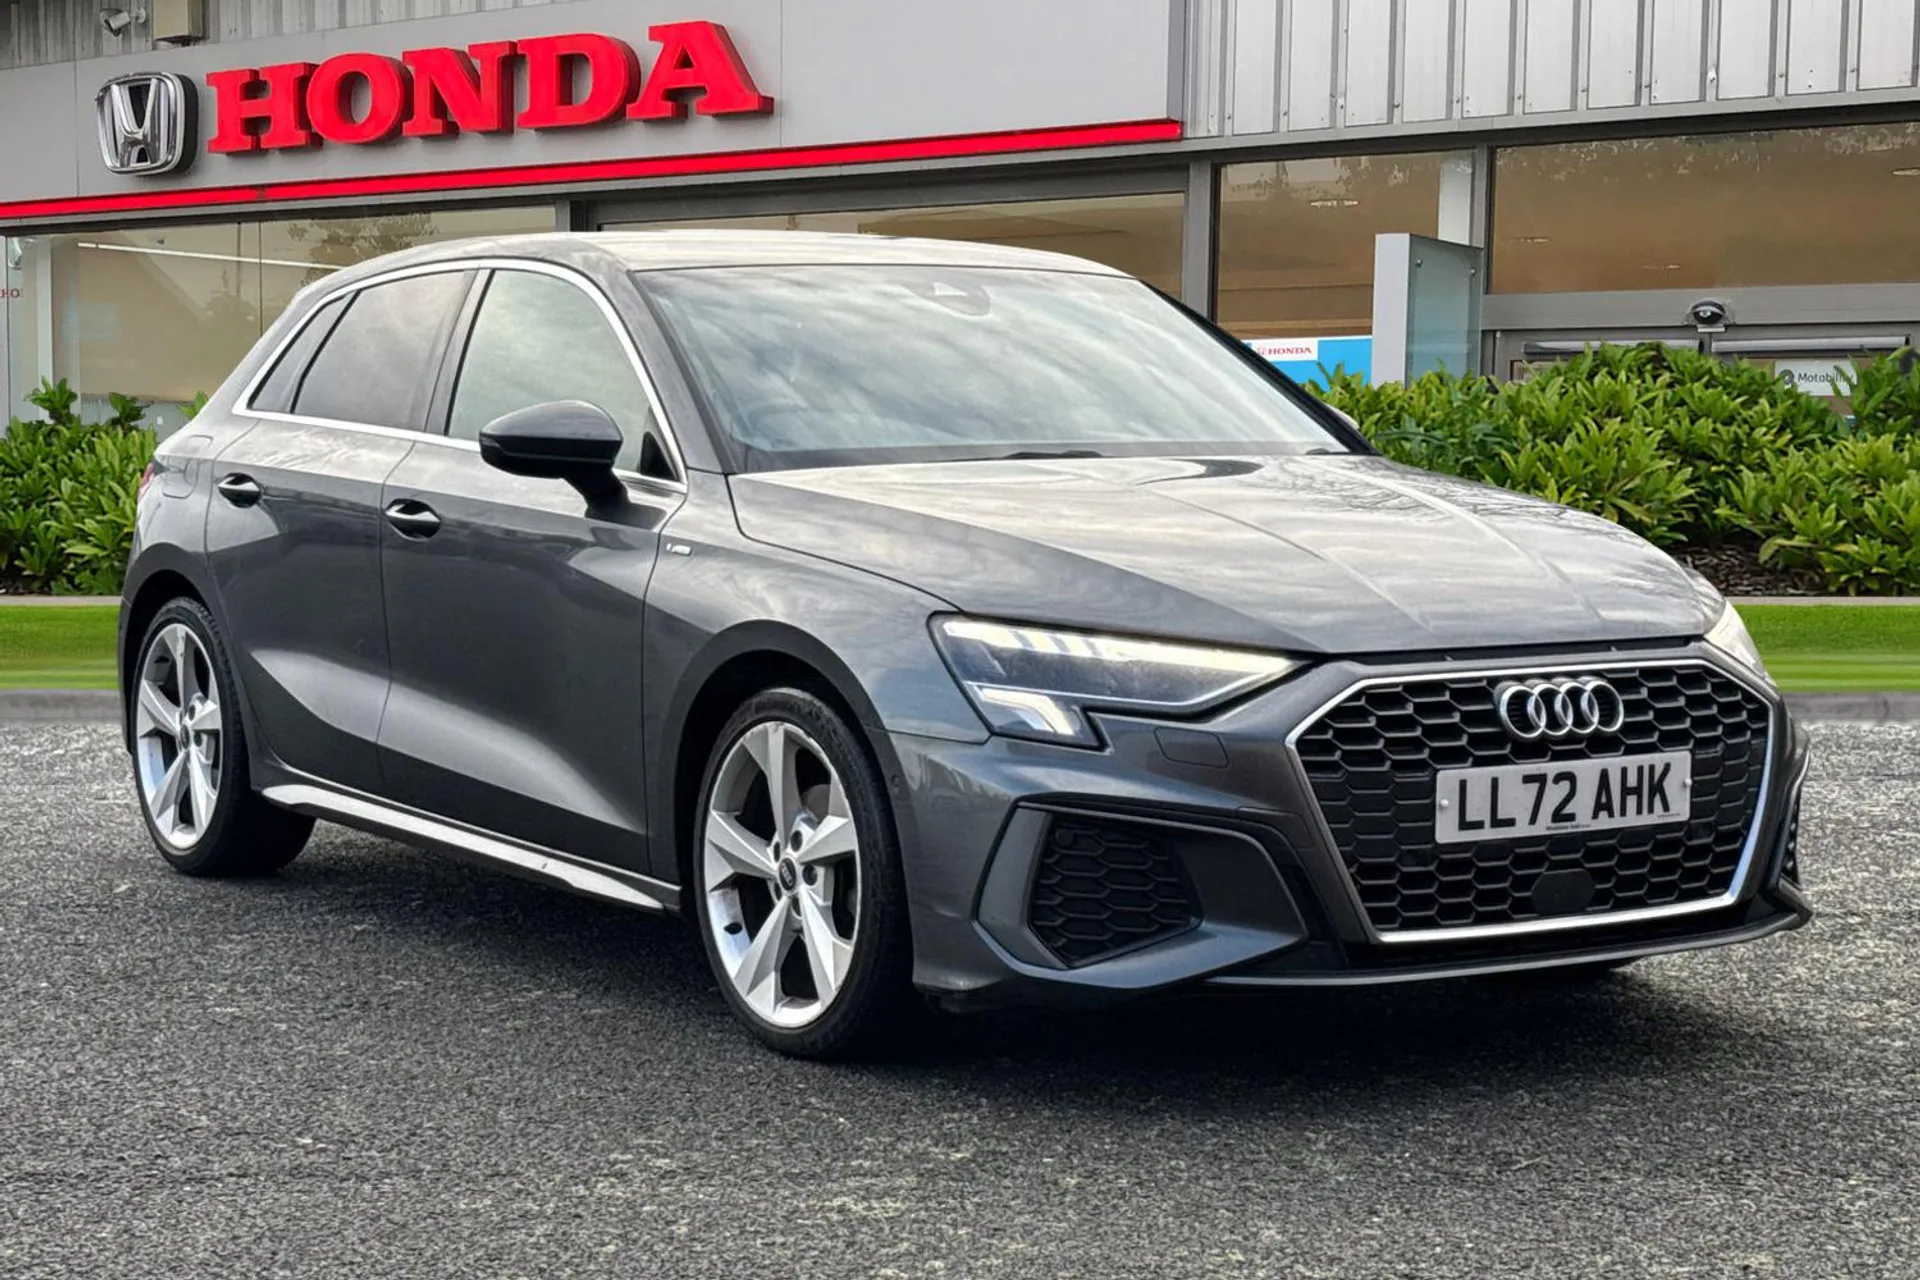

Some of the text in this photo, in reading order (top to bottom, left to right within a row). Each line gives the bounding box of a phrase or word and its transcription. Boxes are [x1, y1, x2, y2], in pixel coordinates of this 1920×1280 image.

[206, 20, 774, 155] HONDA
[1267, 346, 1312, 355] HONDA
[1458, 762, 1671, 831] LL72 AHK
